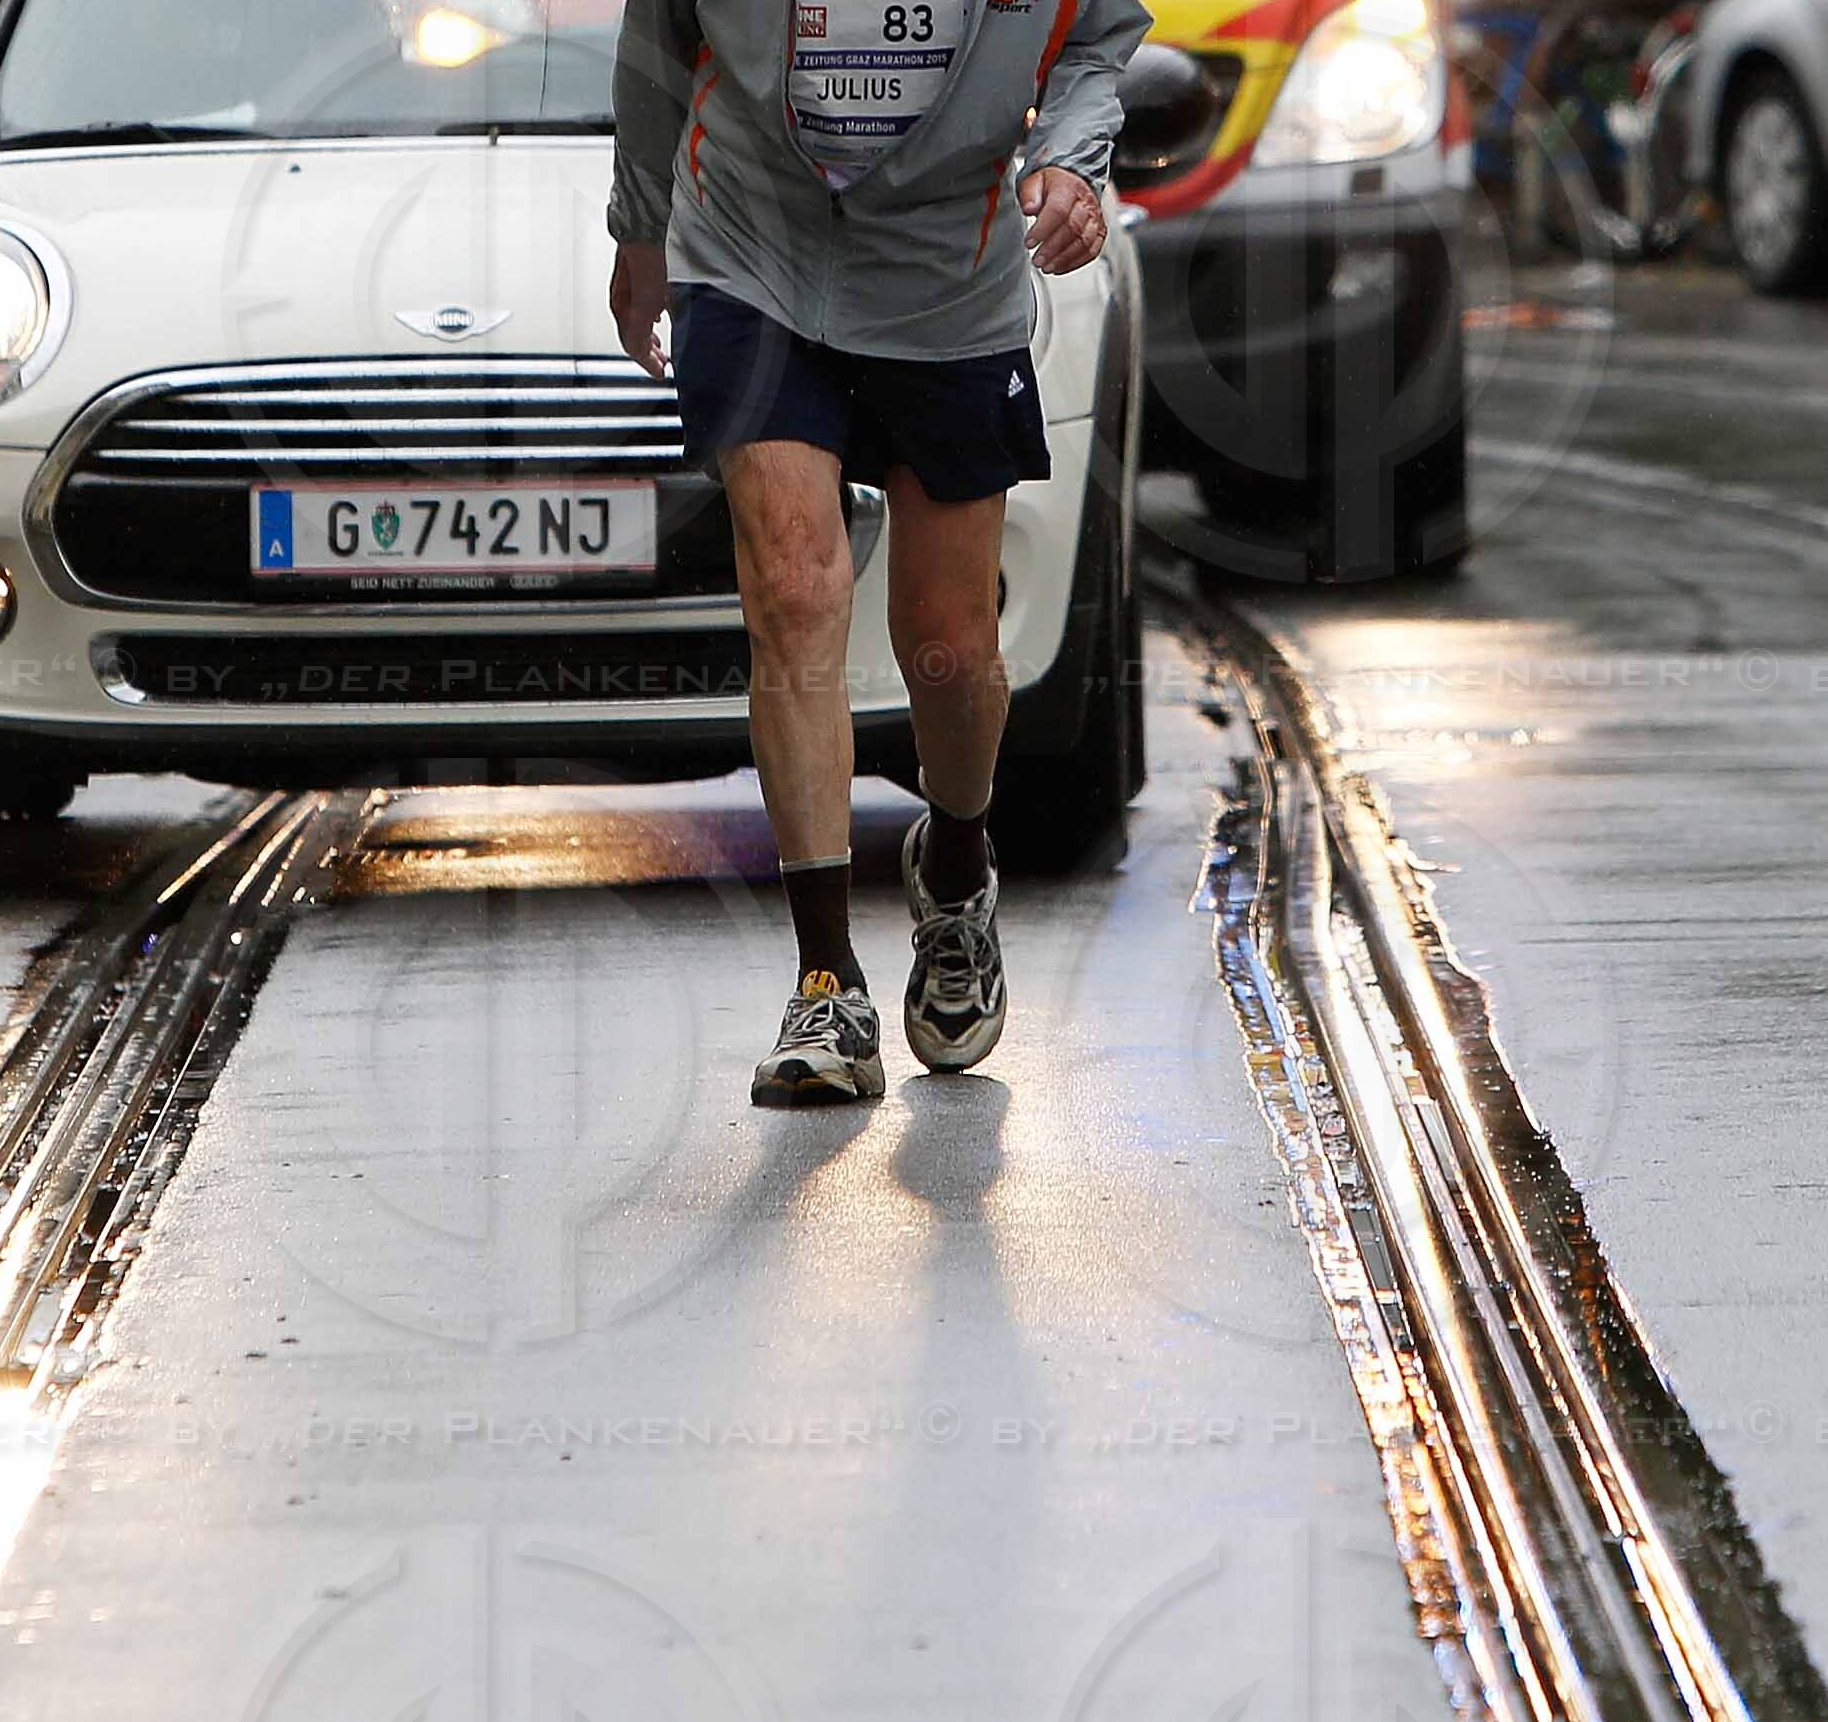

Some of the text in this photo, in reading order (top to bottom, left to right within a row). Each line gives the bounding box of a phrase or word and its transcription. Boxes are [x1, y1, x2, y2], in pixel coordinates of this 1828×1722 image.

[882, 4, 935, 43] 83
[804, 53, 948, 66] ZEITUNG GRAZ MARATHON 2015
[816, 77, 902, 101] JULIUS
[846, 121, 896, 133] Marathon
[435, 312, 471, 327] MINI
[327, 496, 609, 557] G 742 NJ
[268, 539, 284, 557] A
